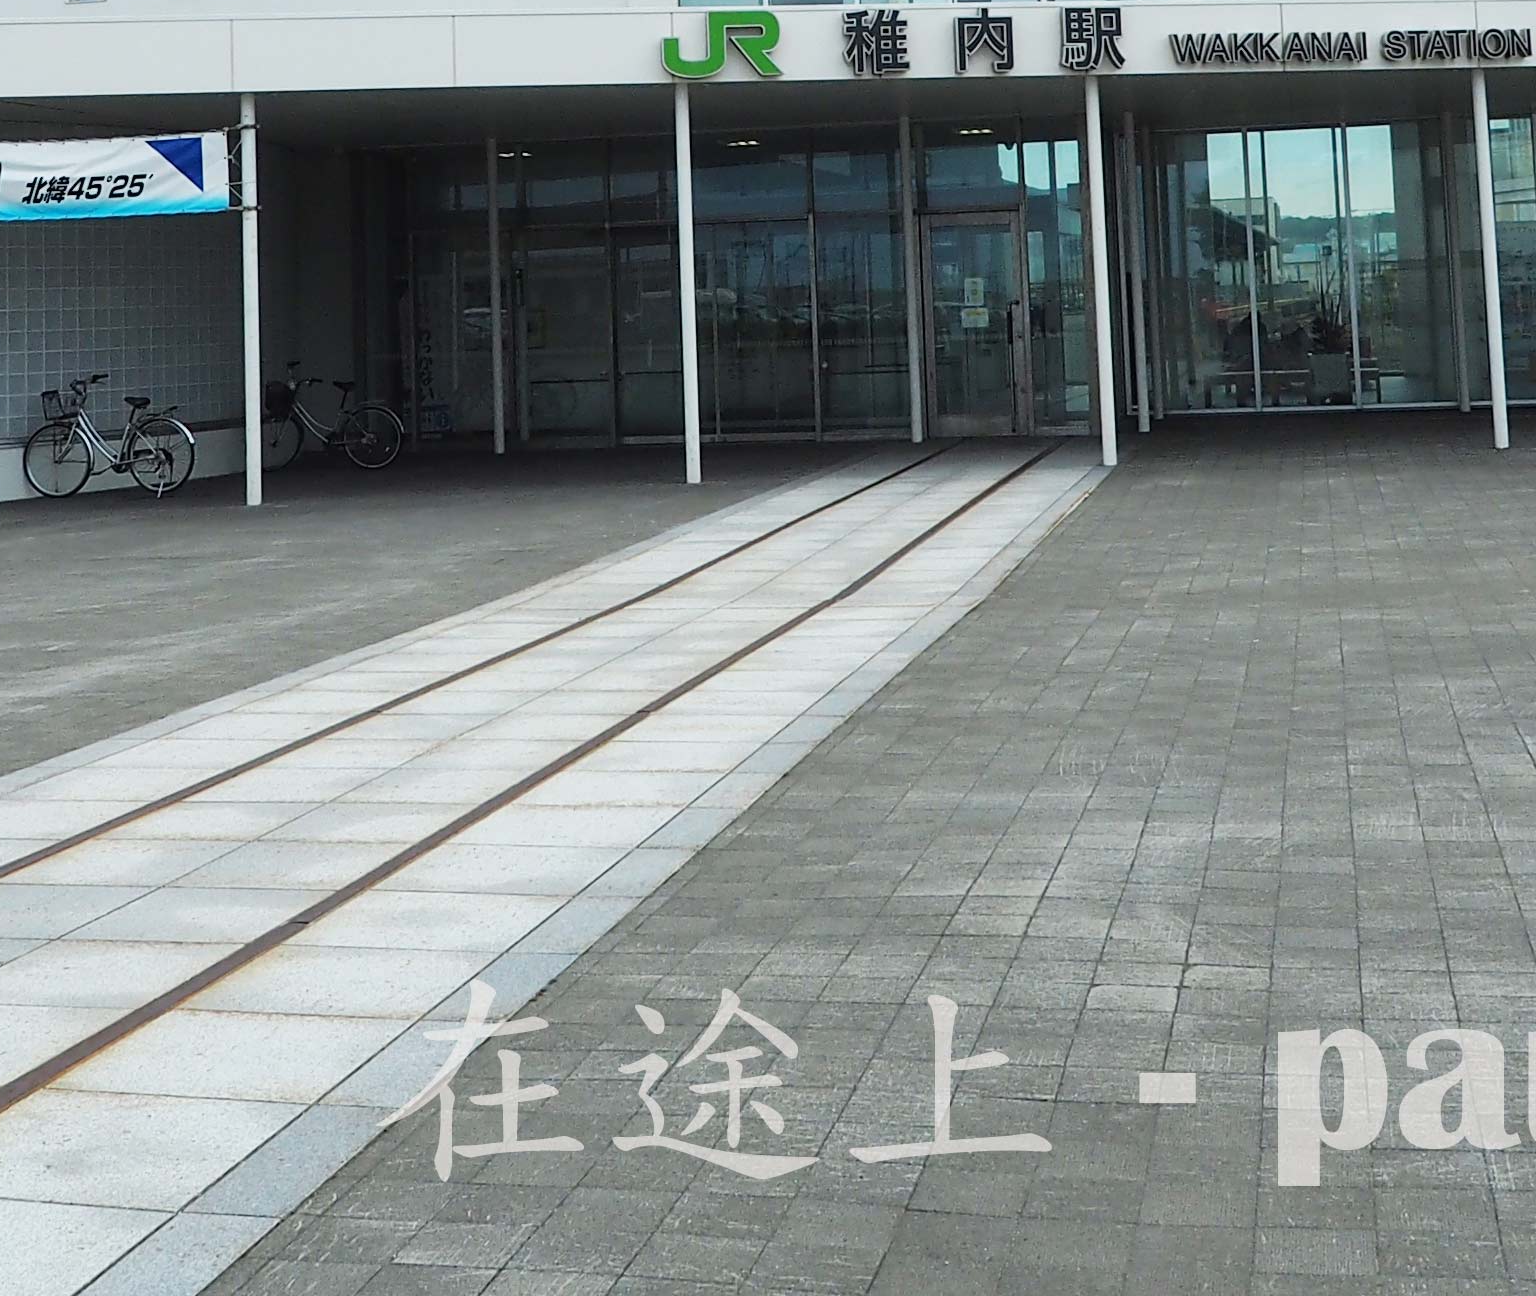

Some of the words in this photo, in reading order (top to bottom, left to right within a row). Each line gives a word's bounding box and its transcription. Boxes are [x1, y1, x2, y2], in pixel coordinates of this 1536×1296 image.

[662, 10, 783, 79] JR
[841, 7, 1126, 77] 稚内駅
[1169, 31, 1368, 65] WAKKANAI
[1382, 27, 1534, 63] STATION
